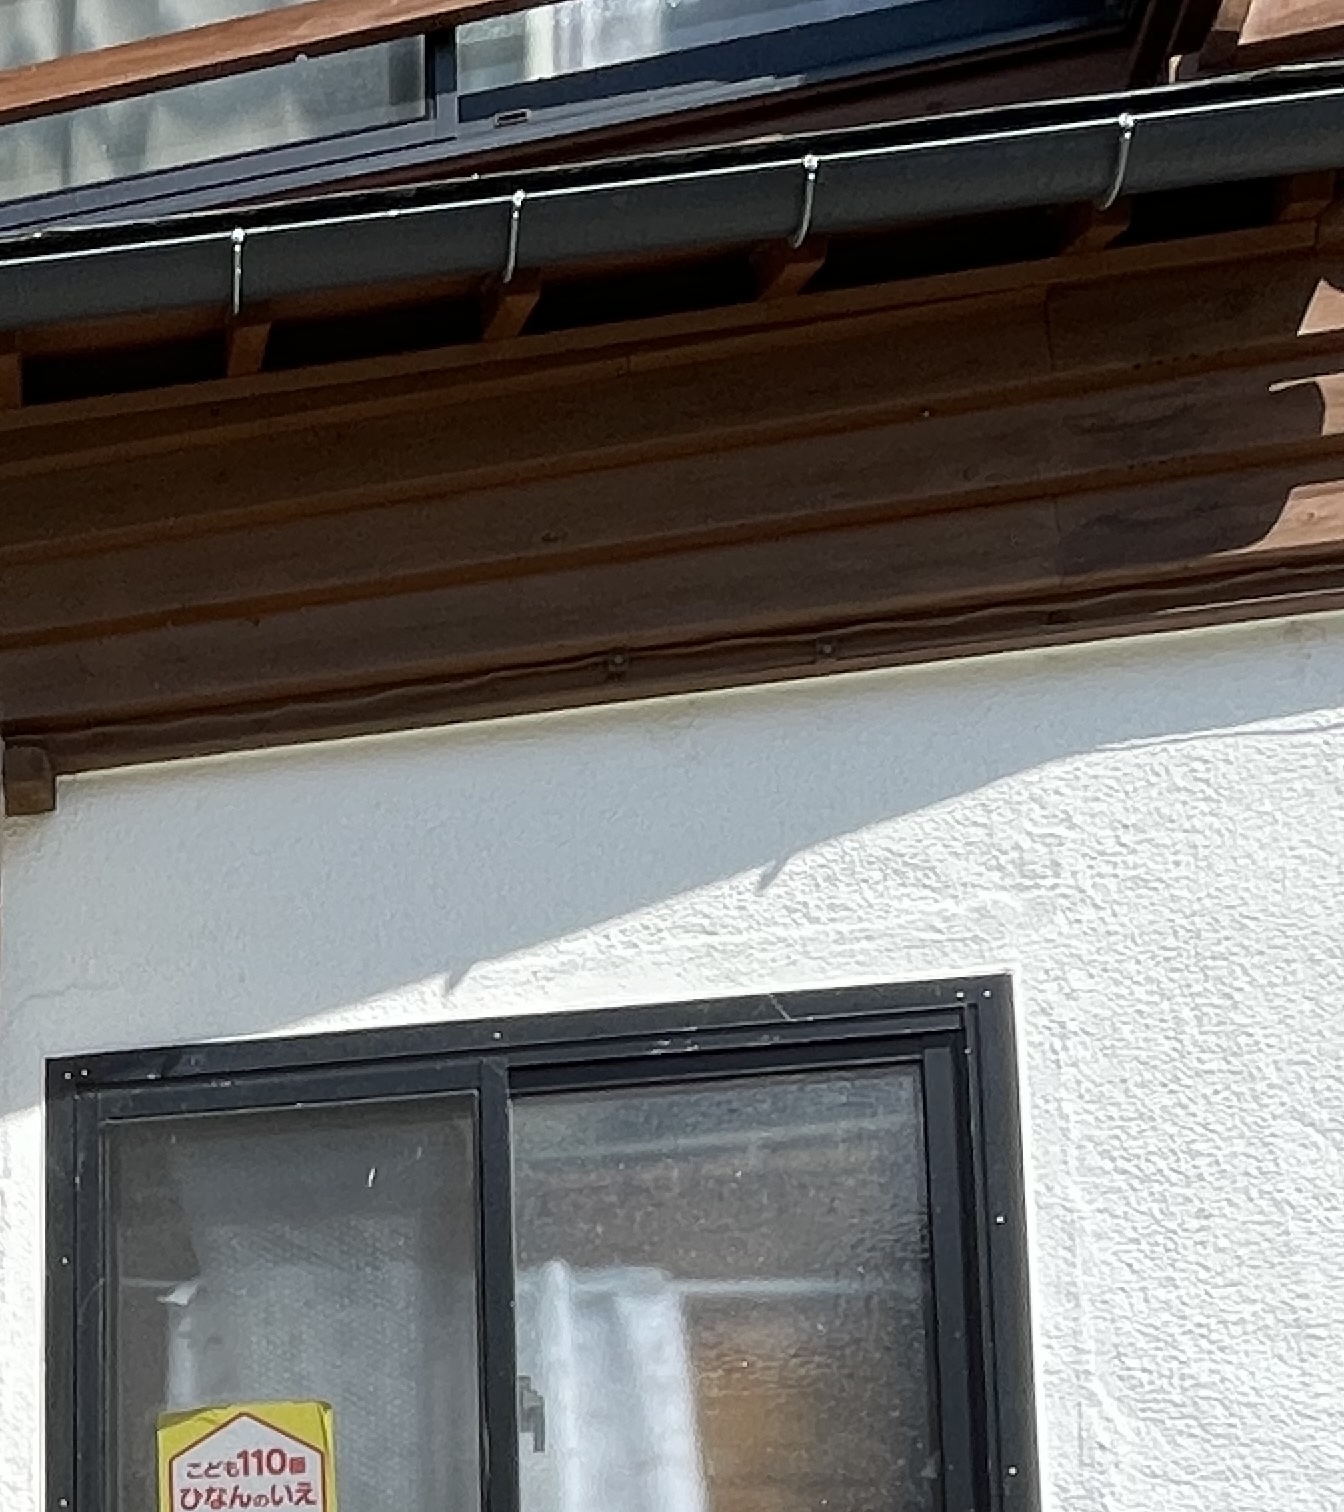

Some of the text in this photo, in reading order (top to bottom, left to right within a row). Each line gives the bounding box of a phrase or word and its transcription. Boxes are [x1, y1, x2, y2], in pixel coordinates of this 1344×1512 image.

[187, 1449, 306, 1479] こども110番
[179, 1481, 318, 1511] ひなんのいえ
